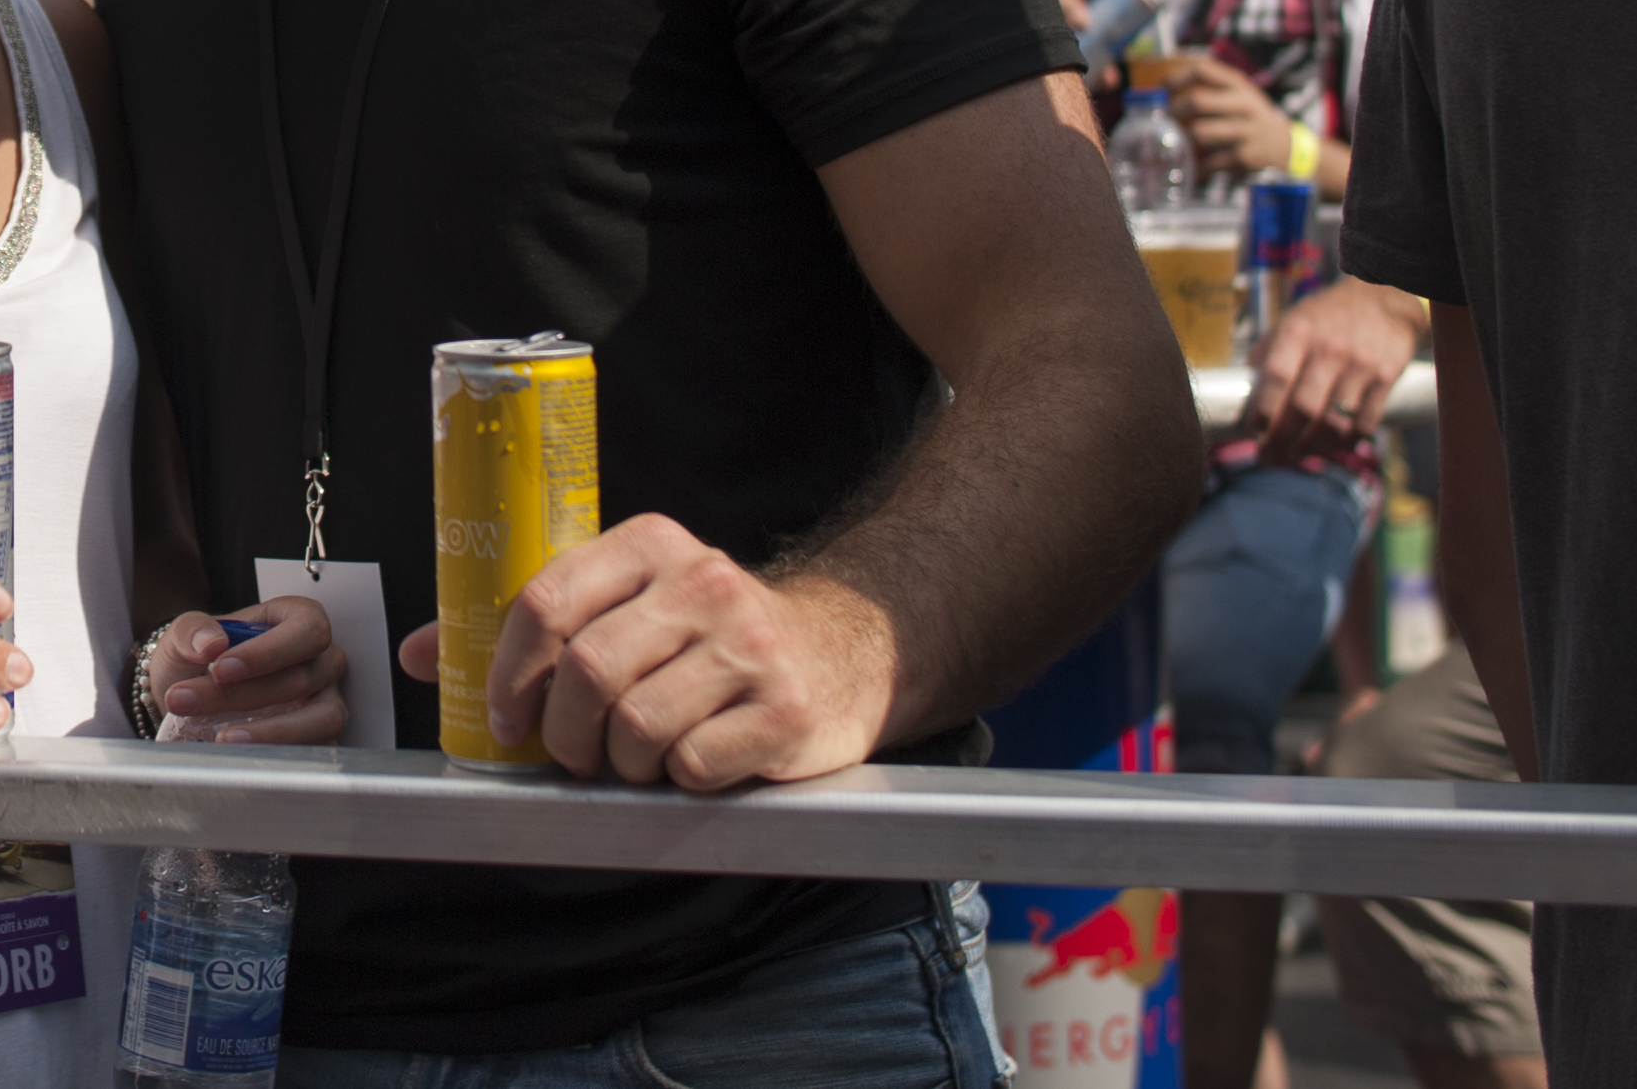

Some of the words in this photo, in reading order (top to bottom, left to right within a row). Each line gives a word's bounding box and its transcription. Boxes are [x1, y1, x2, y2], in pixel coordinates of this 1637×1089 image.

[24, 915, 49, 930] SAVON
[197, 1036, 217, 1054] EAU
[219, 1038, 233, 1055] DE
[1001, 1003, 1162, 1069] ERGY
